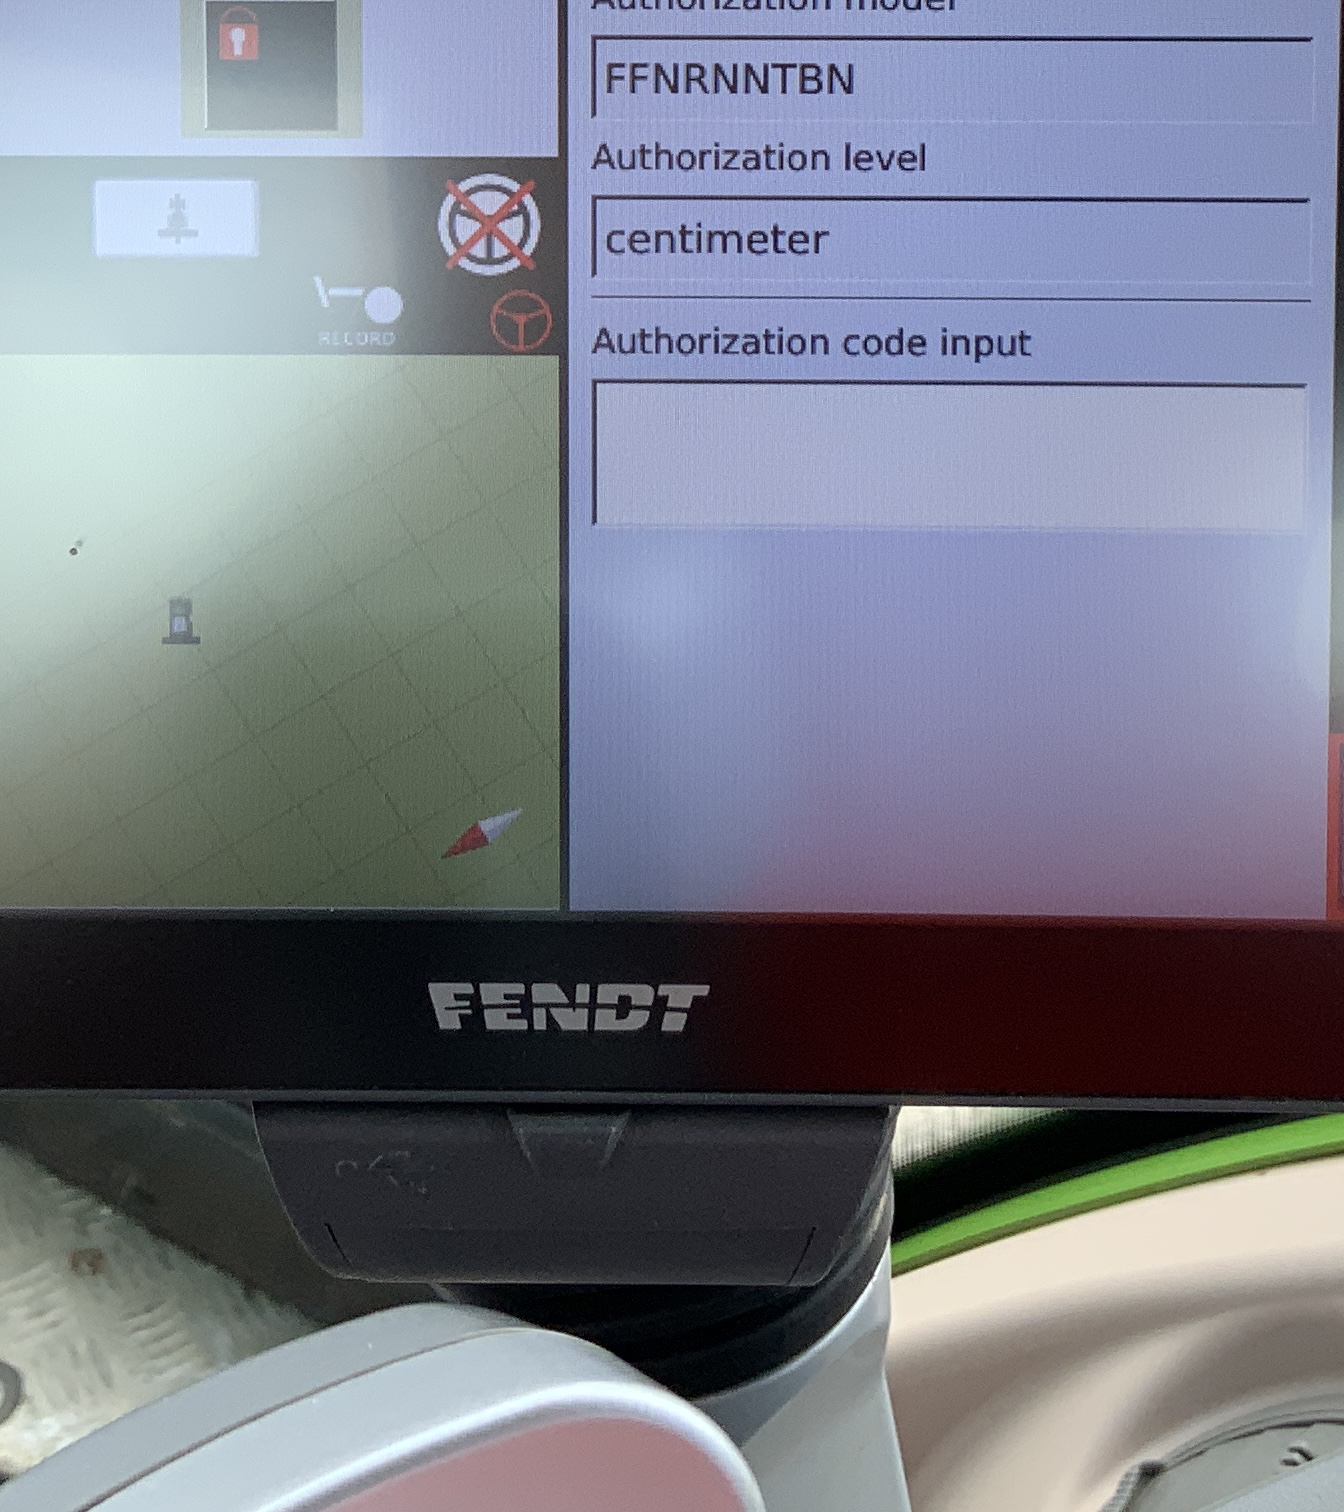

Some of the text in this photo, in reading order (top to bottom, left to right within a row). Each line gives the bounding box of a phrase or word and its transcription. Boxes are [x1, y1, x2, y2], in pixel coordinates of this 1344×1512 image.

[606, 62, 855, 95] FFNRNNTBN
[591, 142, 927, 171] Authorization level
[605, 223, 829, 255] centimeter
[591, 326, 1032, 363] Authorization code input
[428, 982, 710, 1032] FENDT
